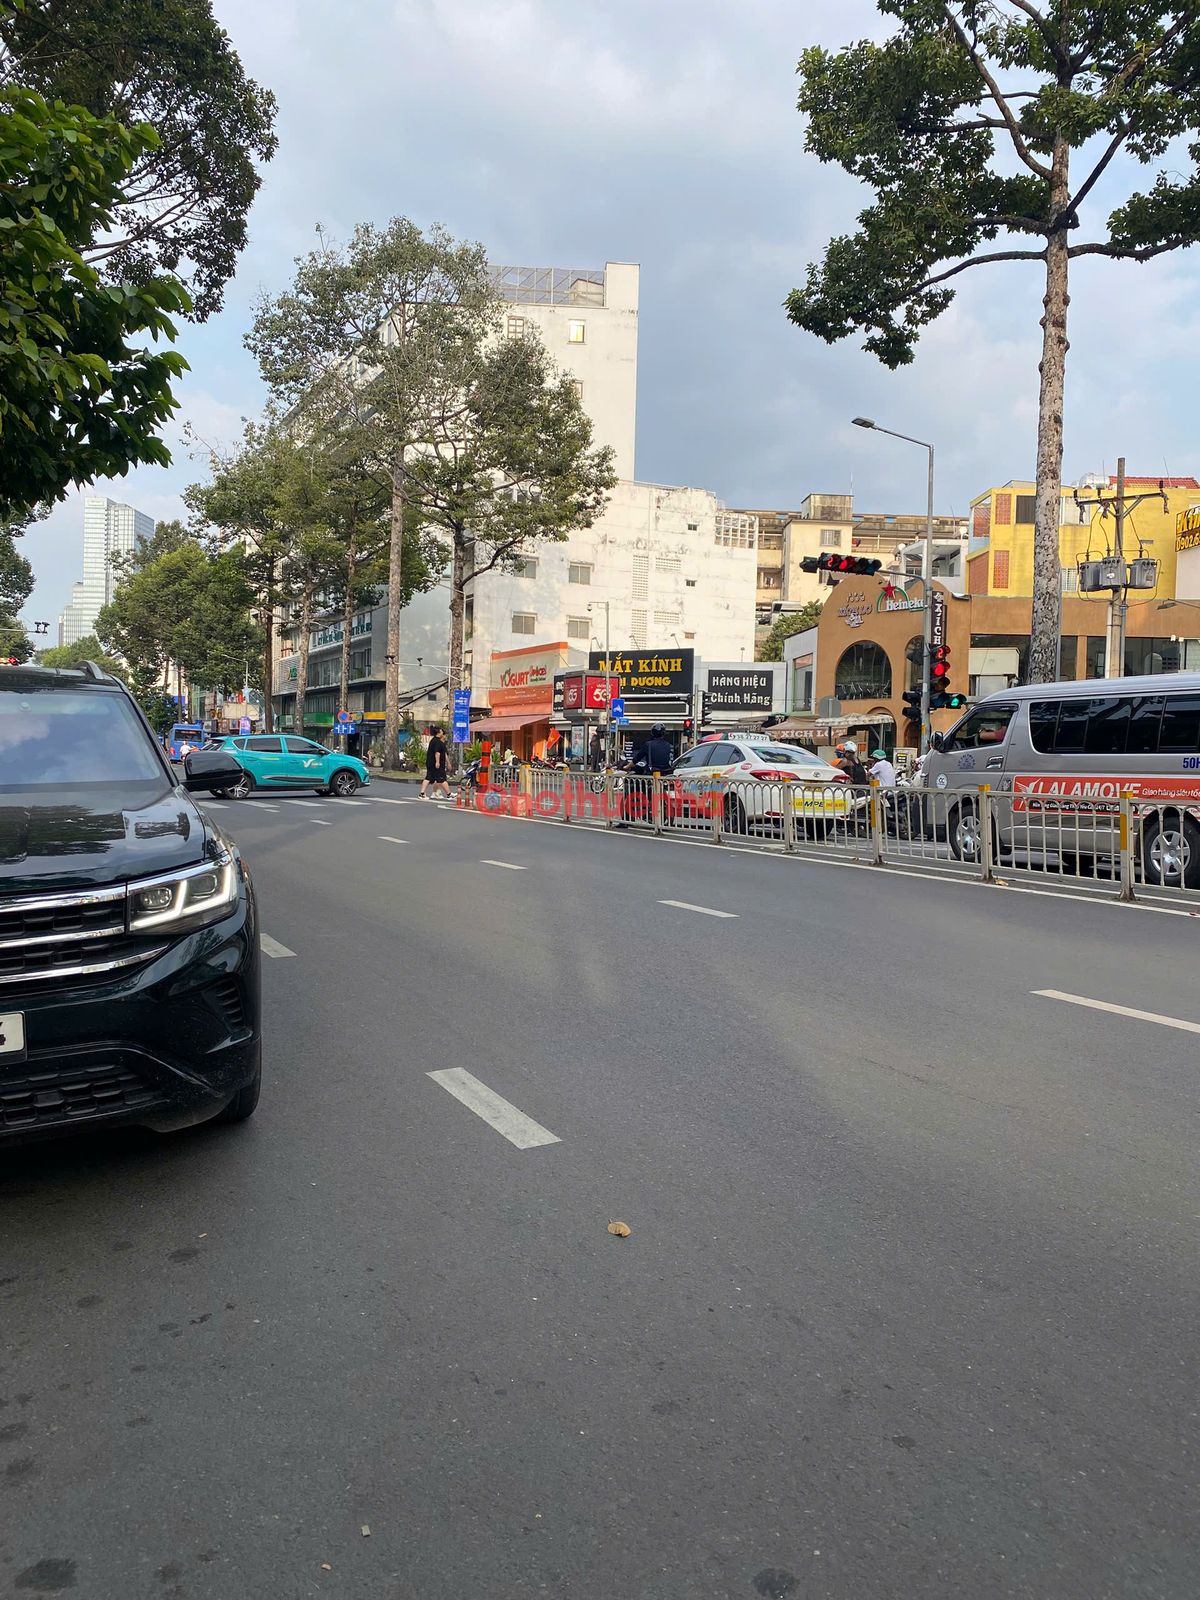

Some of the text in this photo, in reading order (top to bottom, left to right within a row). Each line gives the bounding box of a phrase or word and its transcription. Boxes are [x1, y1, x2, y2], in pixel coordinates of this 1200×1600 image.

[598, 652, 683, 672] MẮT KÍNH
[631, 675, 671, 687] DƯƠNG
[712, 673, 767, 688] HÀNG HIỆU
[710, 692, 771, 706] Chính Hãng
[1037, 781, 1141, 799] LALAMOVE
